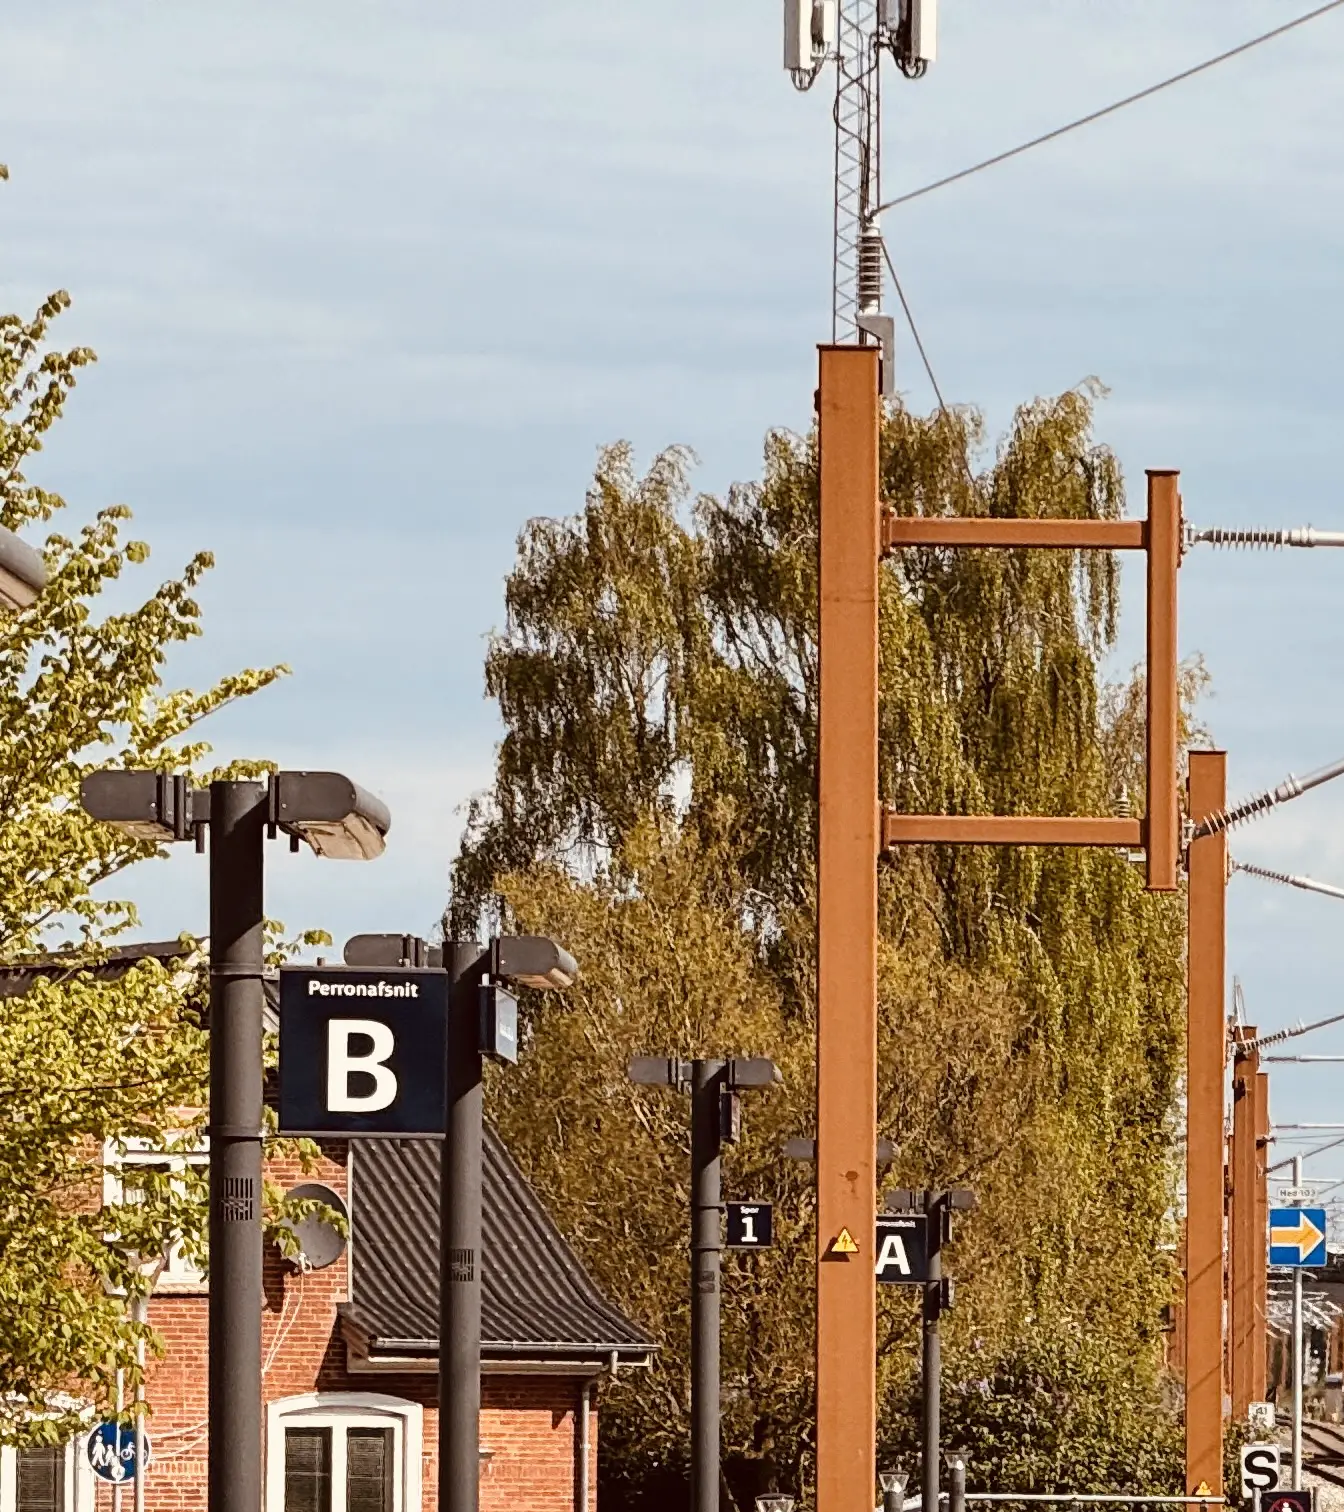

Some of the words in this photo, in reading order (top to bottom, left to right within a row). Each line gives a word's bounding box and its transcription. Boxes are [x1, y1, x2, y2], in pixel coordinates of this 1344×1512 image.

[308, 980, 420, 998] Perronafsnit
[327, 1018, 398, 1113] B
[741, 1216, 759, 1243] 1
[875, 1235, 912, 1275] A
[1243, 1450, 1279, 1492] S
